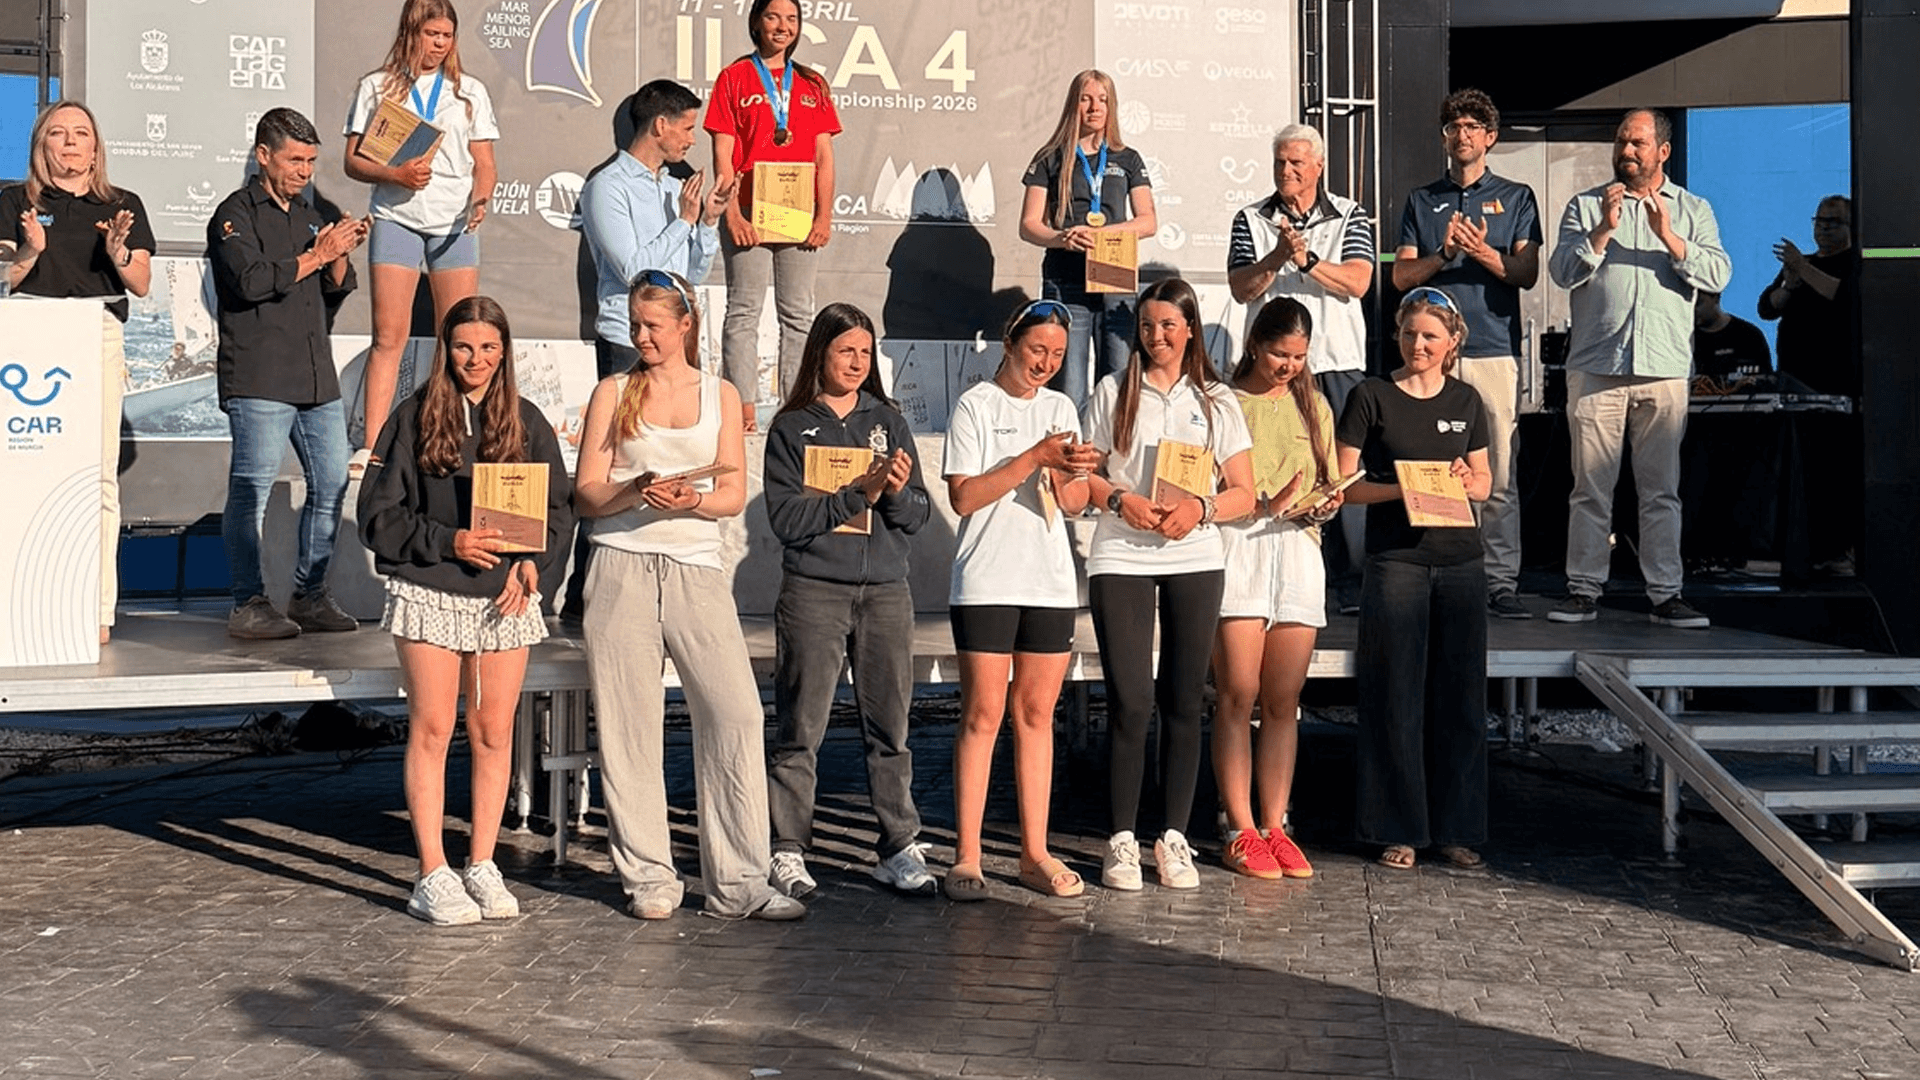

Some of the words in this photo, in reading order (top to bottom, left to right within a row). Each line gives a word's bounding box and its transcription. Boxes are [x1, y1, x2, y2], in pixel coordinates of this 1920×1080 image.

[501, 1, 529, 13] MAR
[801, 0, 860, 22] BRIL
[486, 12, 531, 26] MENOR
[483, 25, 531, 38] SAILING
[488, 37, 512, 49] SEA
[924, 29, 976, 94] 4
[833, 92, 926, 112] pionship
[931, 95, 978, 111] 2026
[493, 199, 530, 215] VELA
[834, 194, 868, 216] CA
[8, 416, 62, 434] CAR
